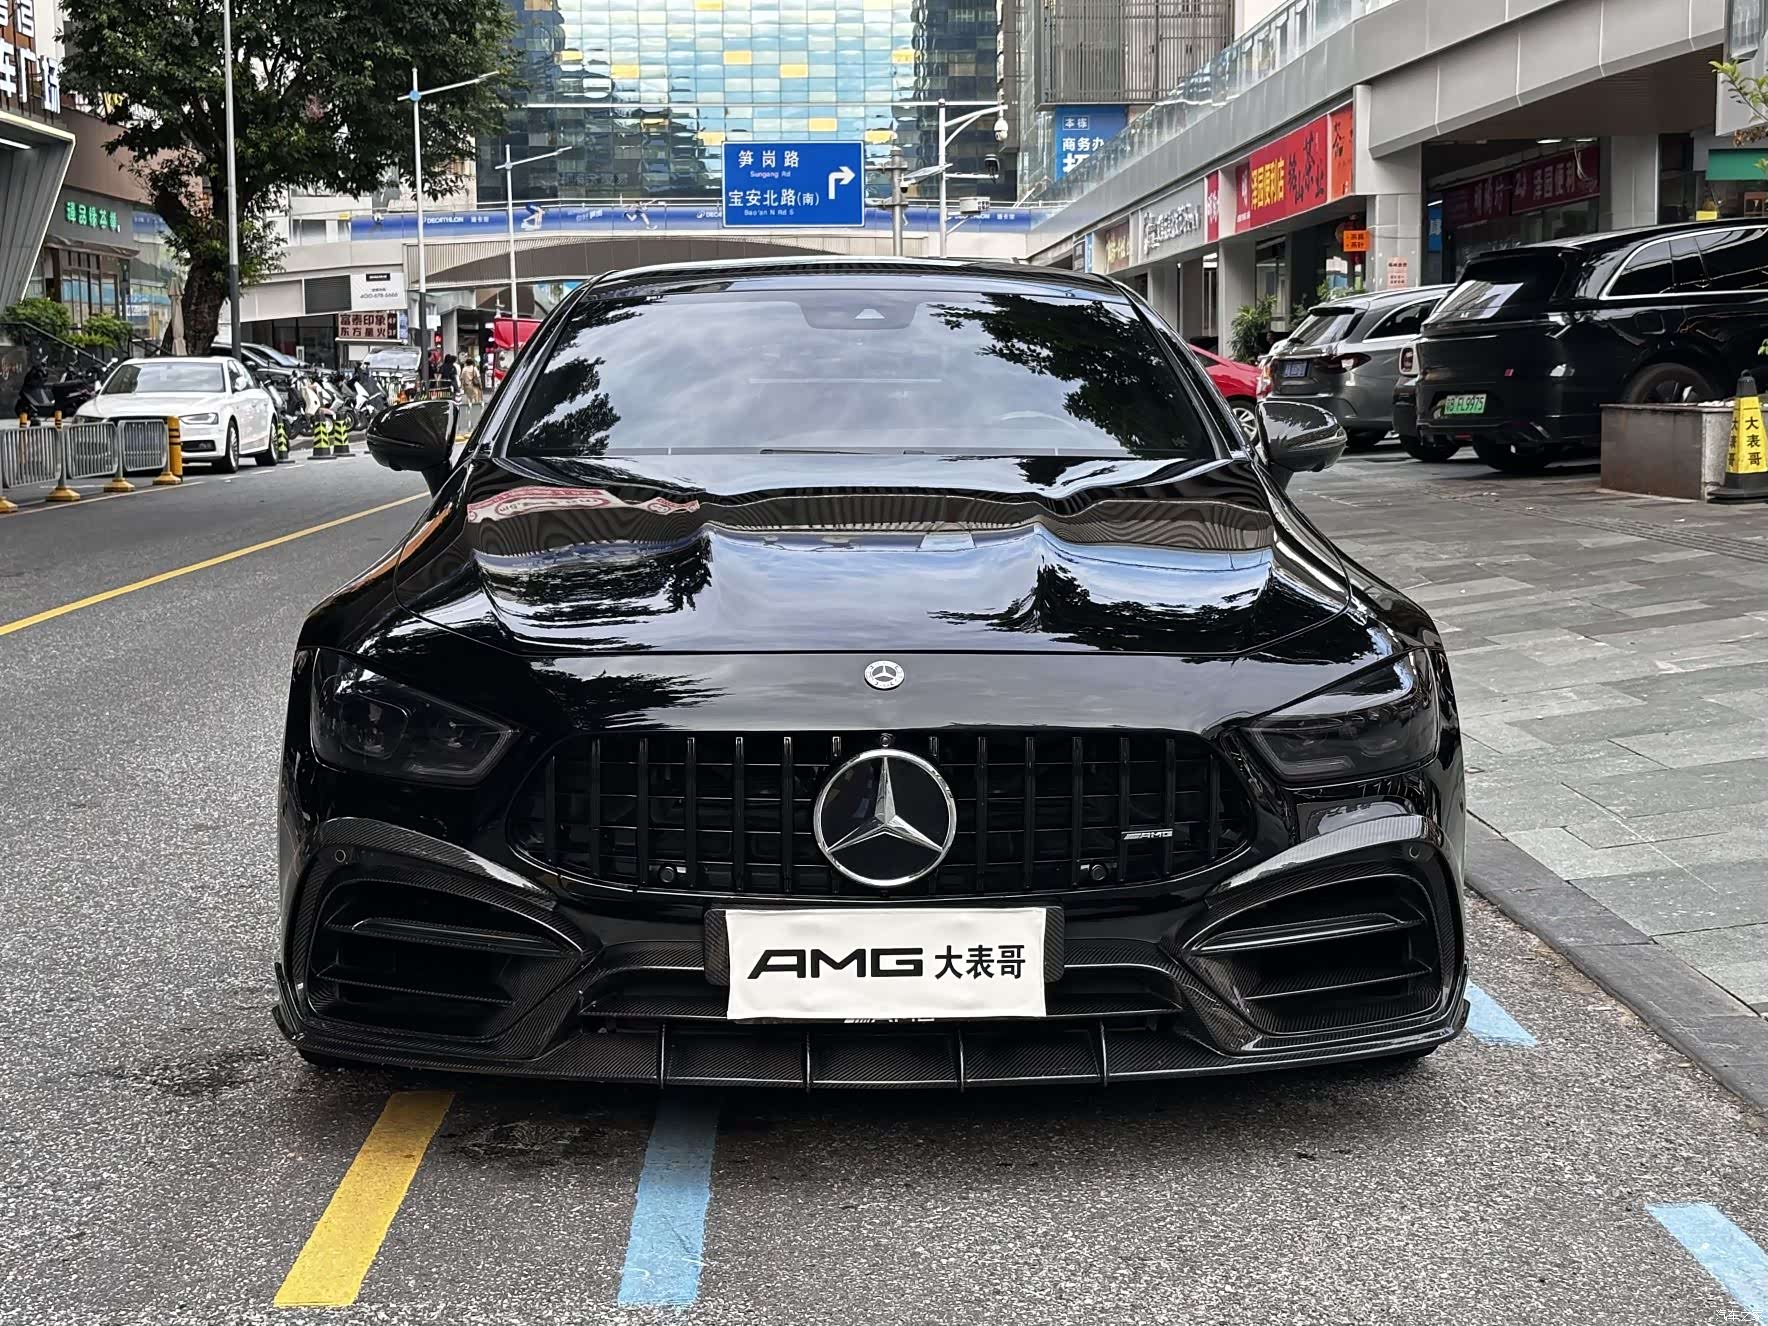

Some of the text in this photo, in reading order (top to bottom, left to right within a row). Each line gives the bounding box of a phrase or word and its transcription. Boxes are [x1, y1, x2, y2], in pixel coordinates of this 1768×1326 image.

[738, 150, 799, 168] 笋岗路
[750, 170, 791, 179] Sungang Rd
[427, 216, 464, 224] DECATHLON
[1745, 416, 1762, 466] 大表哥
[747, 944, 1026, 980] AMG 大表哥
